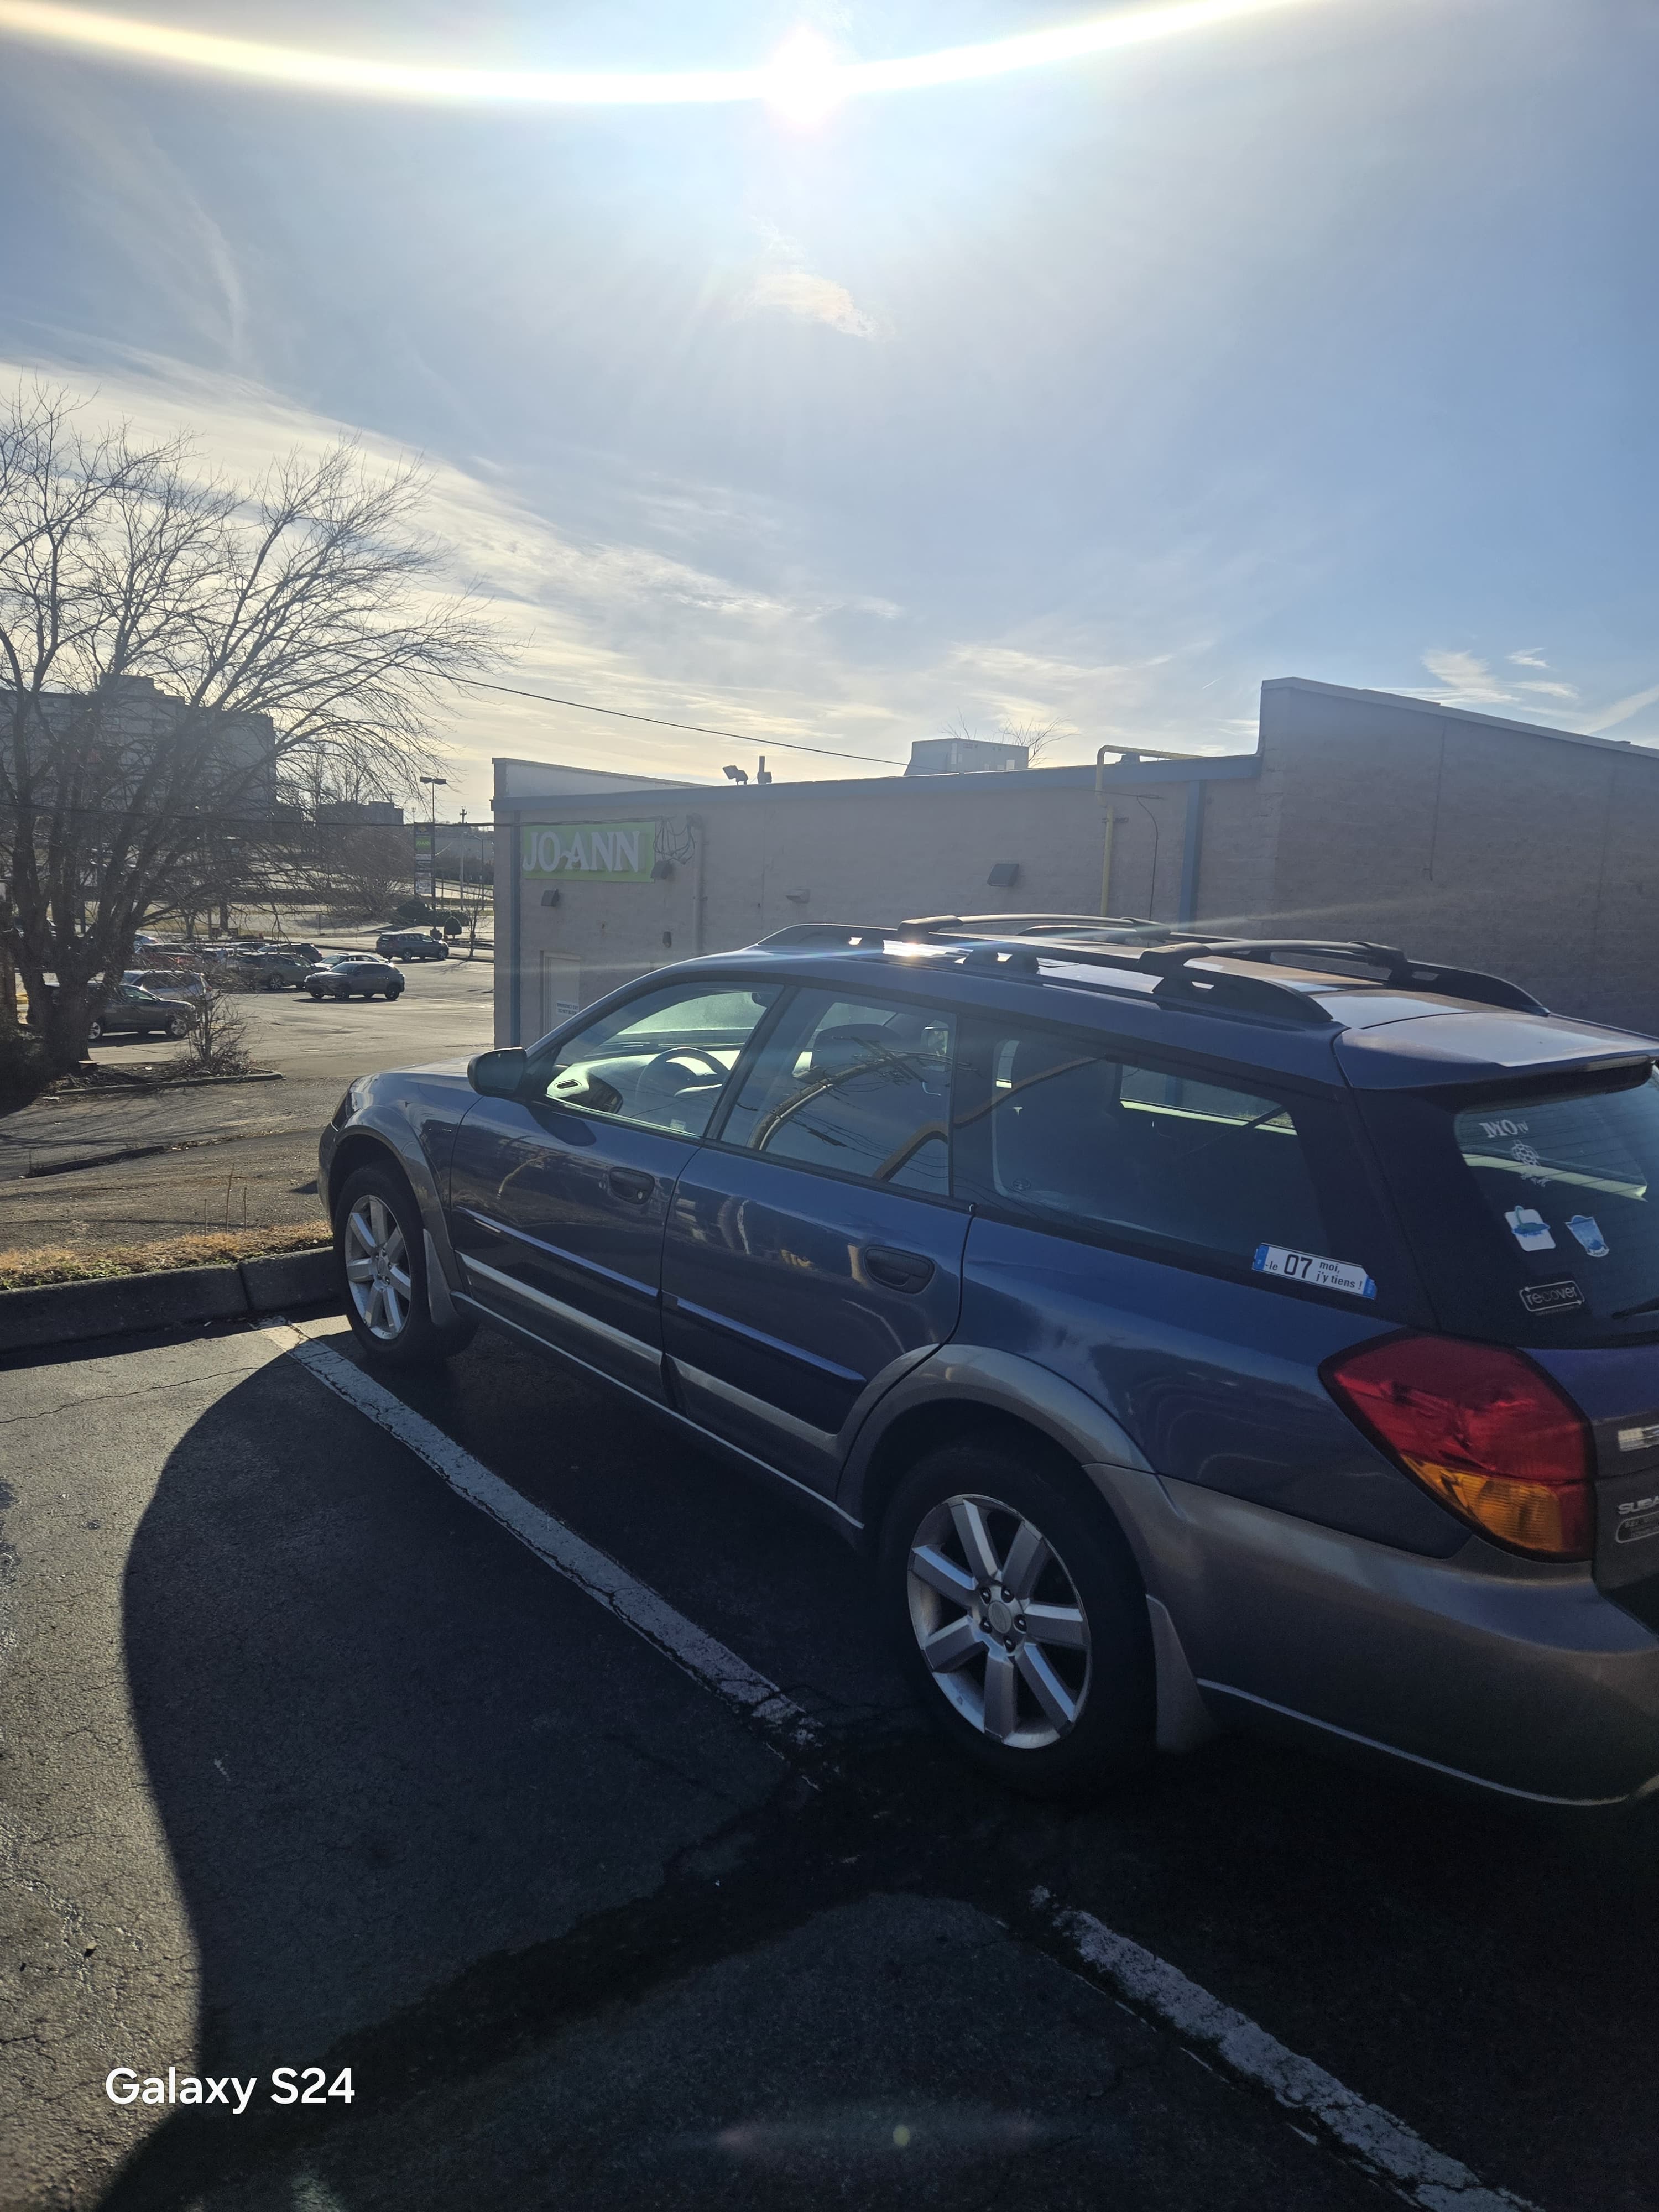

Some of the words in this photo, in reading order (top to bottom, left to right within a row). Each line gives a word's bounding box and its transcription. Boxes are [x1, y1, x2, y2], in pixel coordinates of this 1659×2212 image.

[1284, 1254, 1313, 1279] 07
[1319, 1261, 1340, 1274] moi,
[1316, 1271, 1328, 1284] j'y
[1331, 1273, 1355, 1289] tiens
[1526, 1286, 1577, 1305] recover
